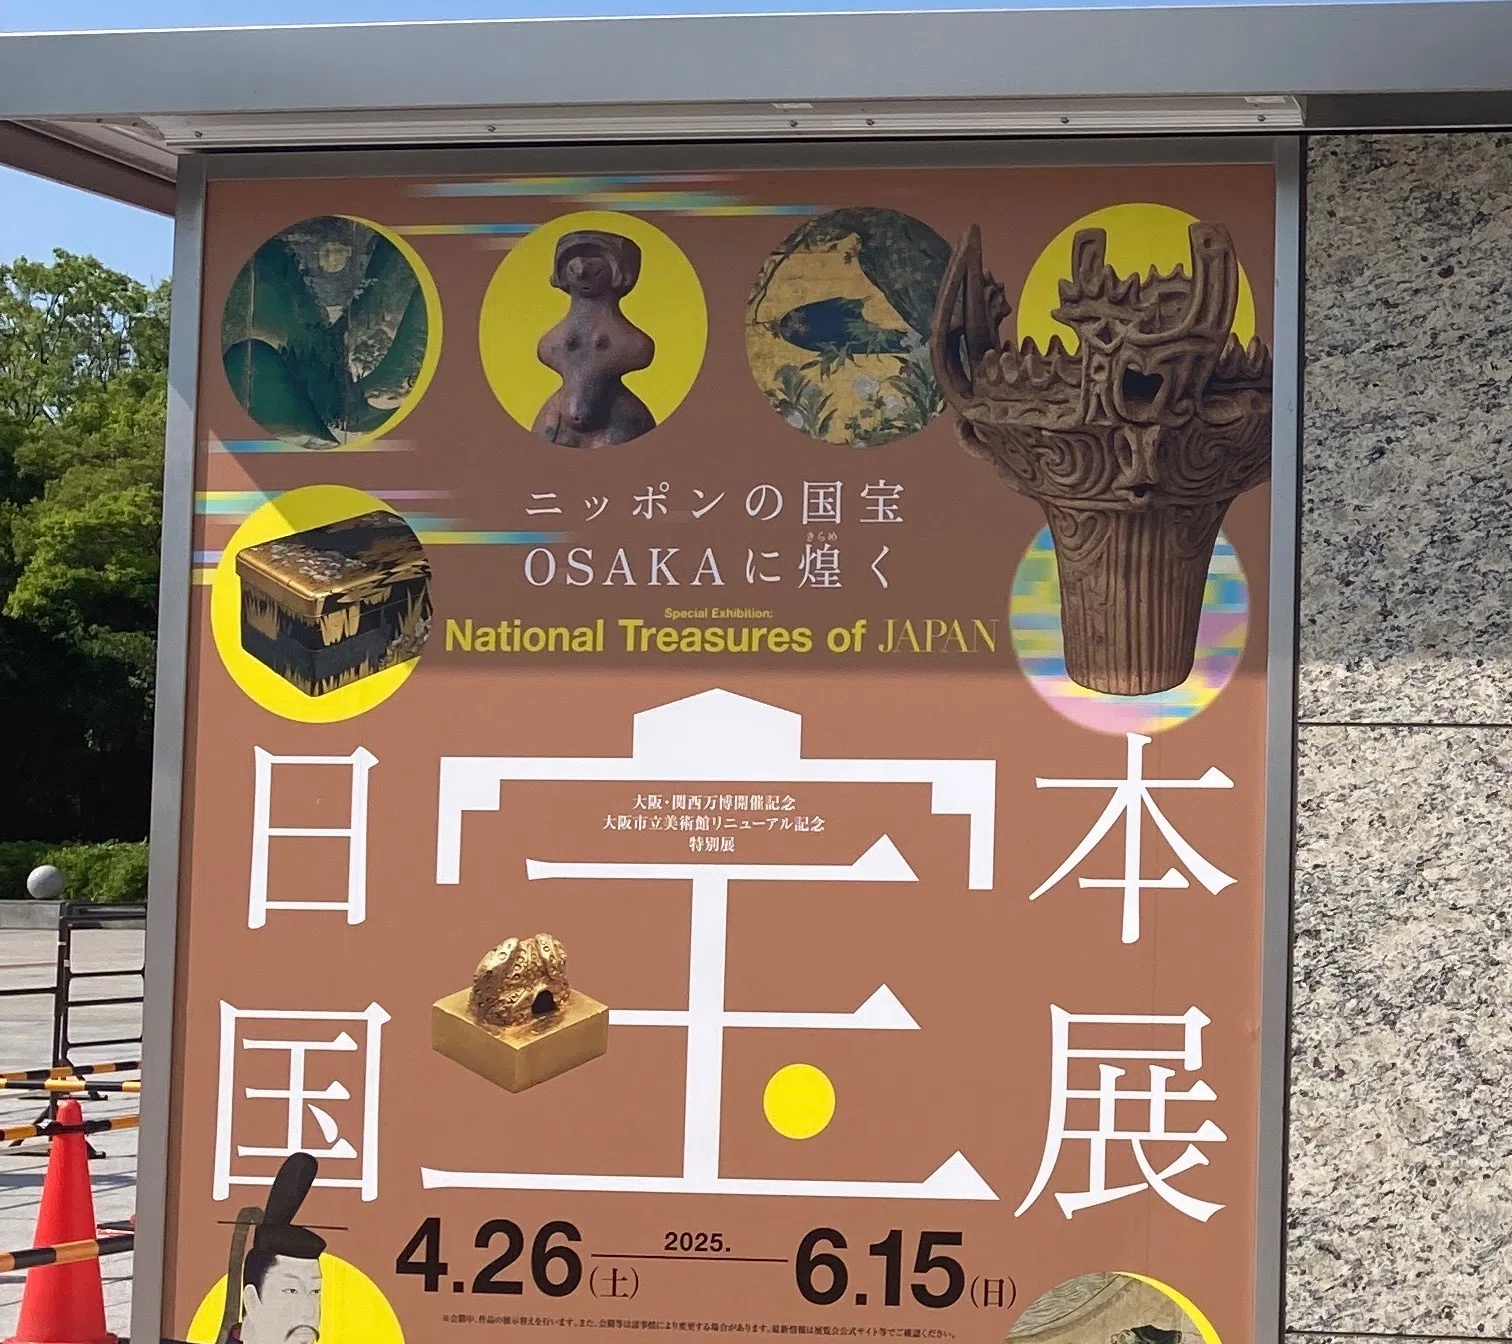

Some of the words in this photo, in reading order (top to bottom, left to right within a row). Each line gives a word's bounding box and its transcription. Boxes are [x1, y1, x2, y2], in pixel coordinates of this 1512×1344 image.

[525, 480, 905, 525] ニッポンの国宝
[524, 544, 891, 590] OSAKAに煌く
[664, 608, 708, 621] Special
[711, 608, 774, 621] Exhibition:
[446, 619, 604, 652] National
[619, 619, 813, 653] Treasures
[828, 619, 867, 653] of
[878, 618, 1000, 654] JAPAN
[632, 794, 796, 812] 大阪・関西万博開催記念
[602, 815, 825, 833] 大阪市立美術館リニューアル記念
[688, 836, 736, 853] 特別展
[664, 1231, 732, 1253] 2025.
